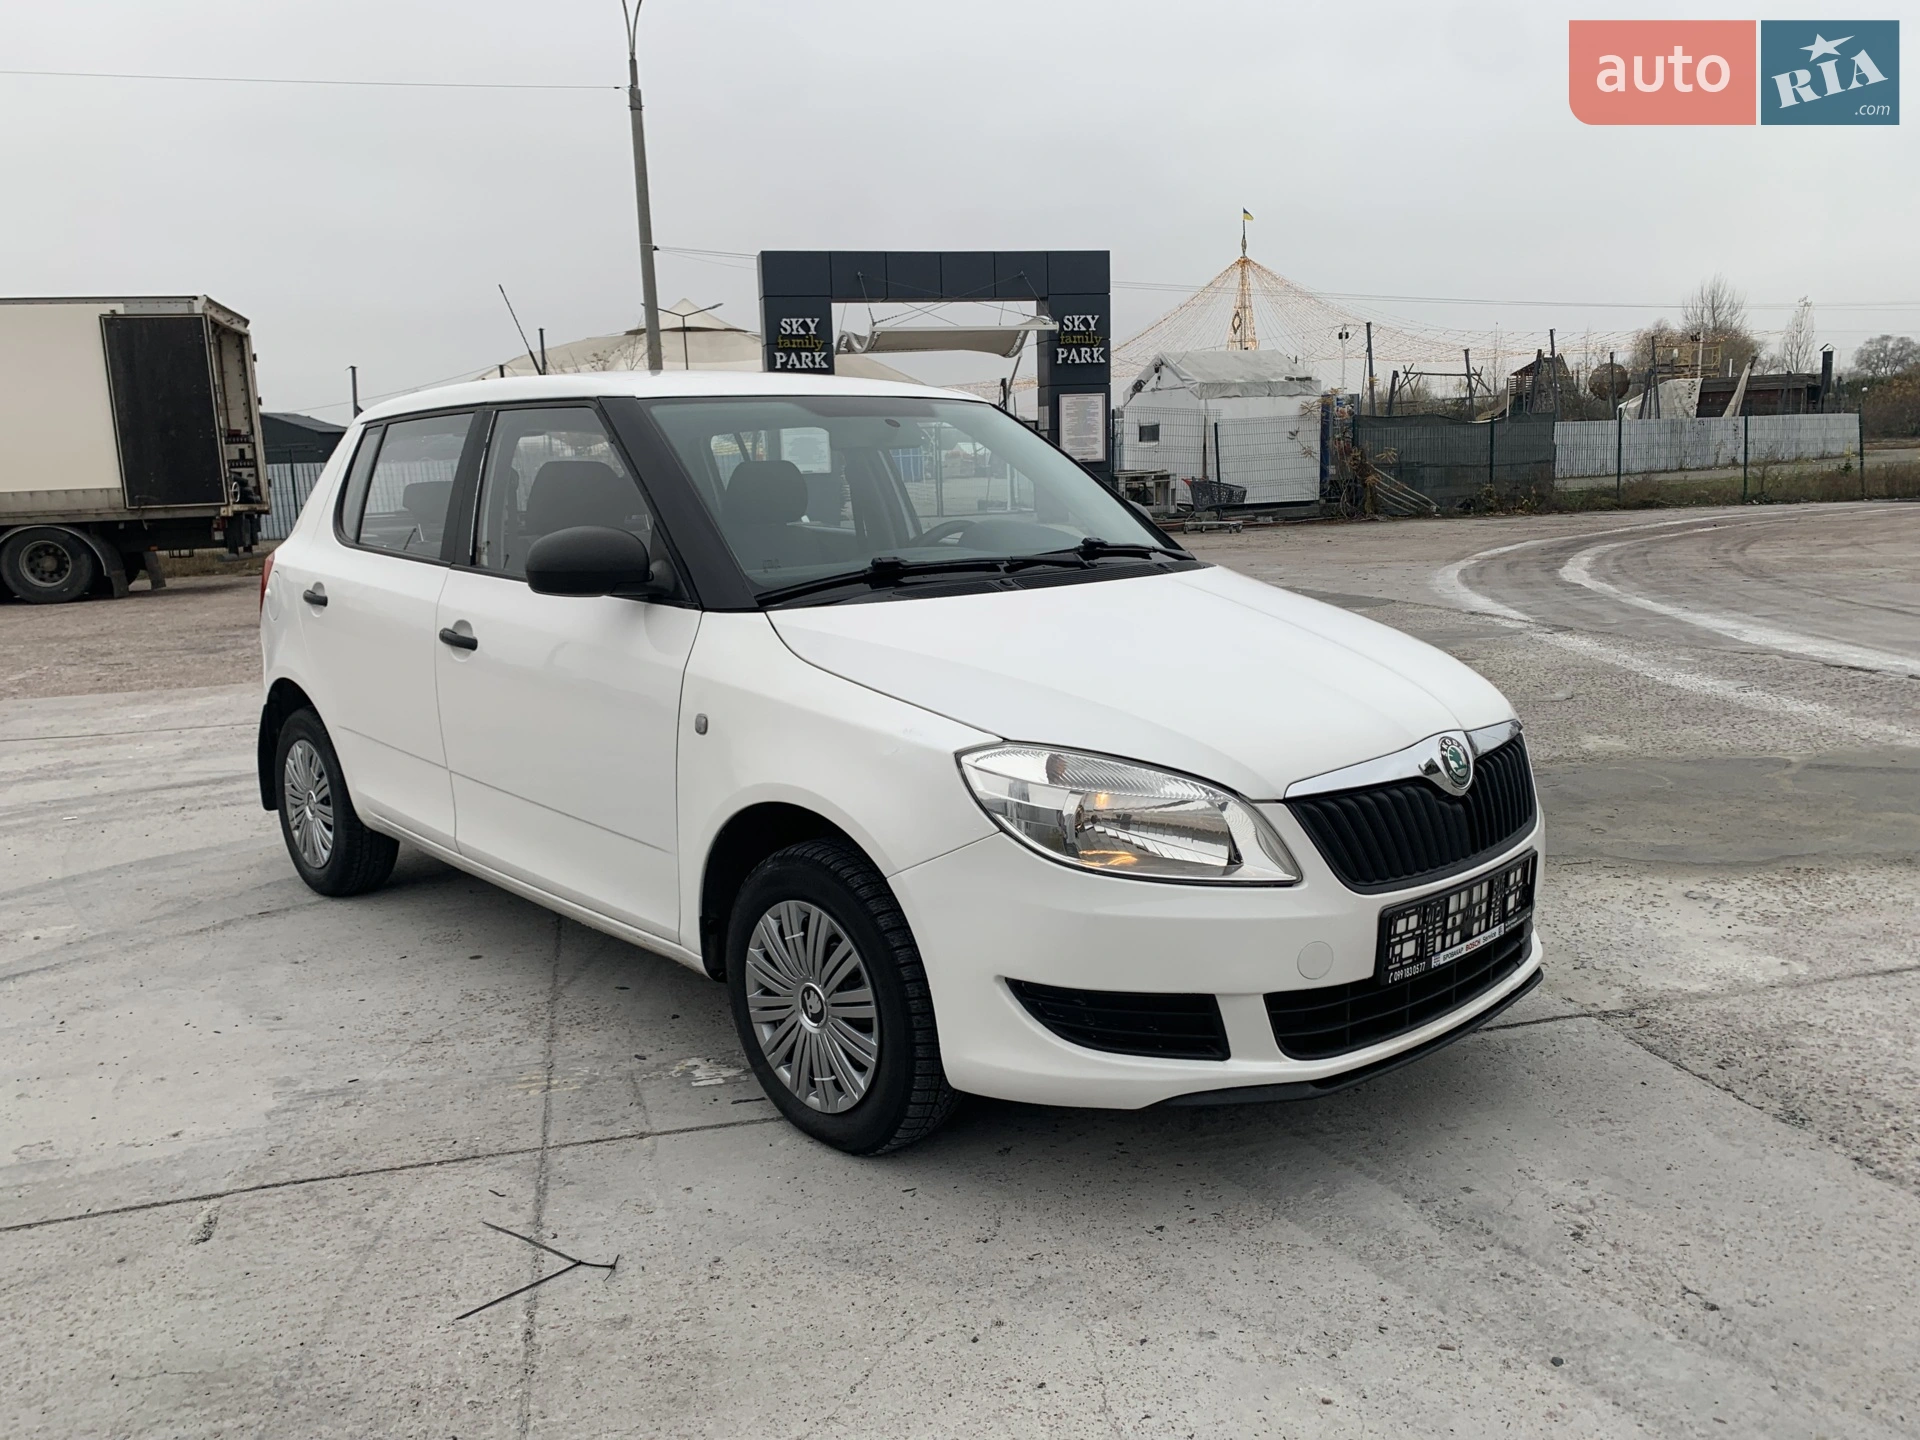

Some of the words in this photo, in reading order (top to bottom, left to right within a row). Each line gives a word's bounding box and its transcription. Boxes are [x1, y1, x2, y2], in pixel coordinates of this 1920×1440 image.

[780, 317, 820, 335] SKY
[1063, 314, 1100, 331] SKY
[777, 334, 825, 352] family
[1060, 331, 1103, 347] family
[774, 351, 829, 369] PARK
[1056, 347, 1106, 364] PARK
